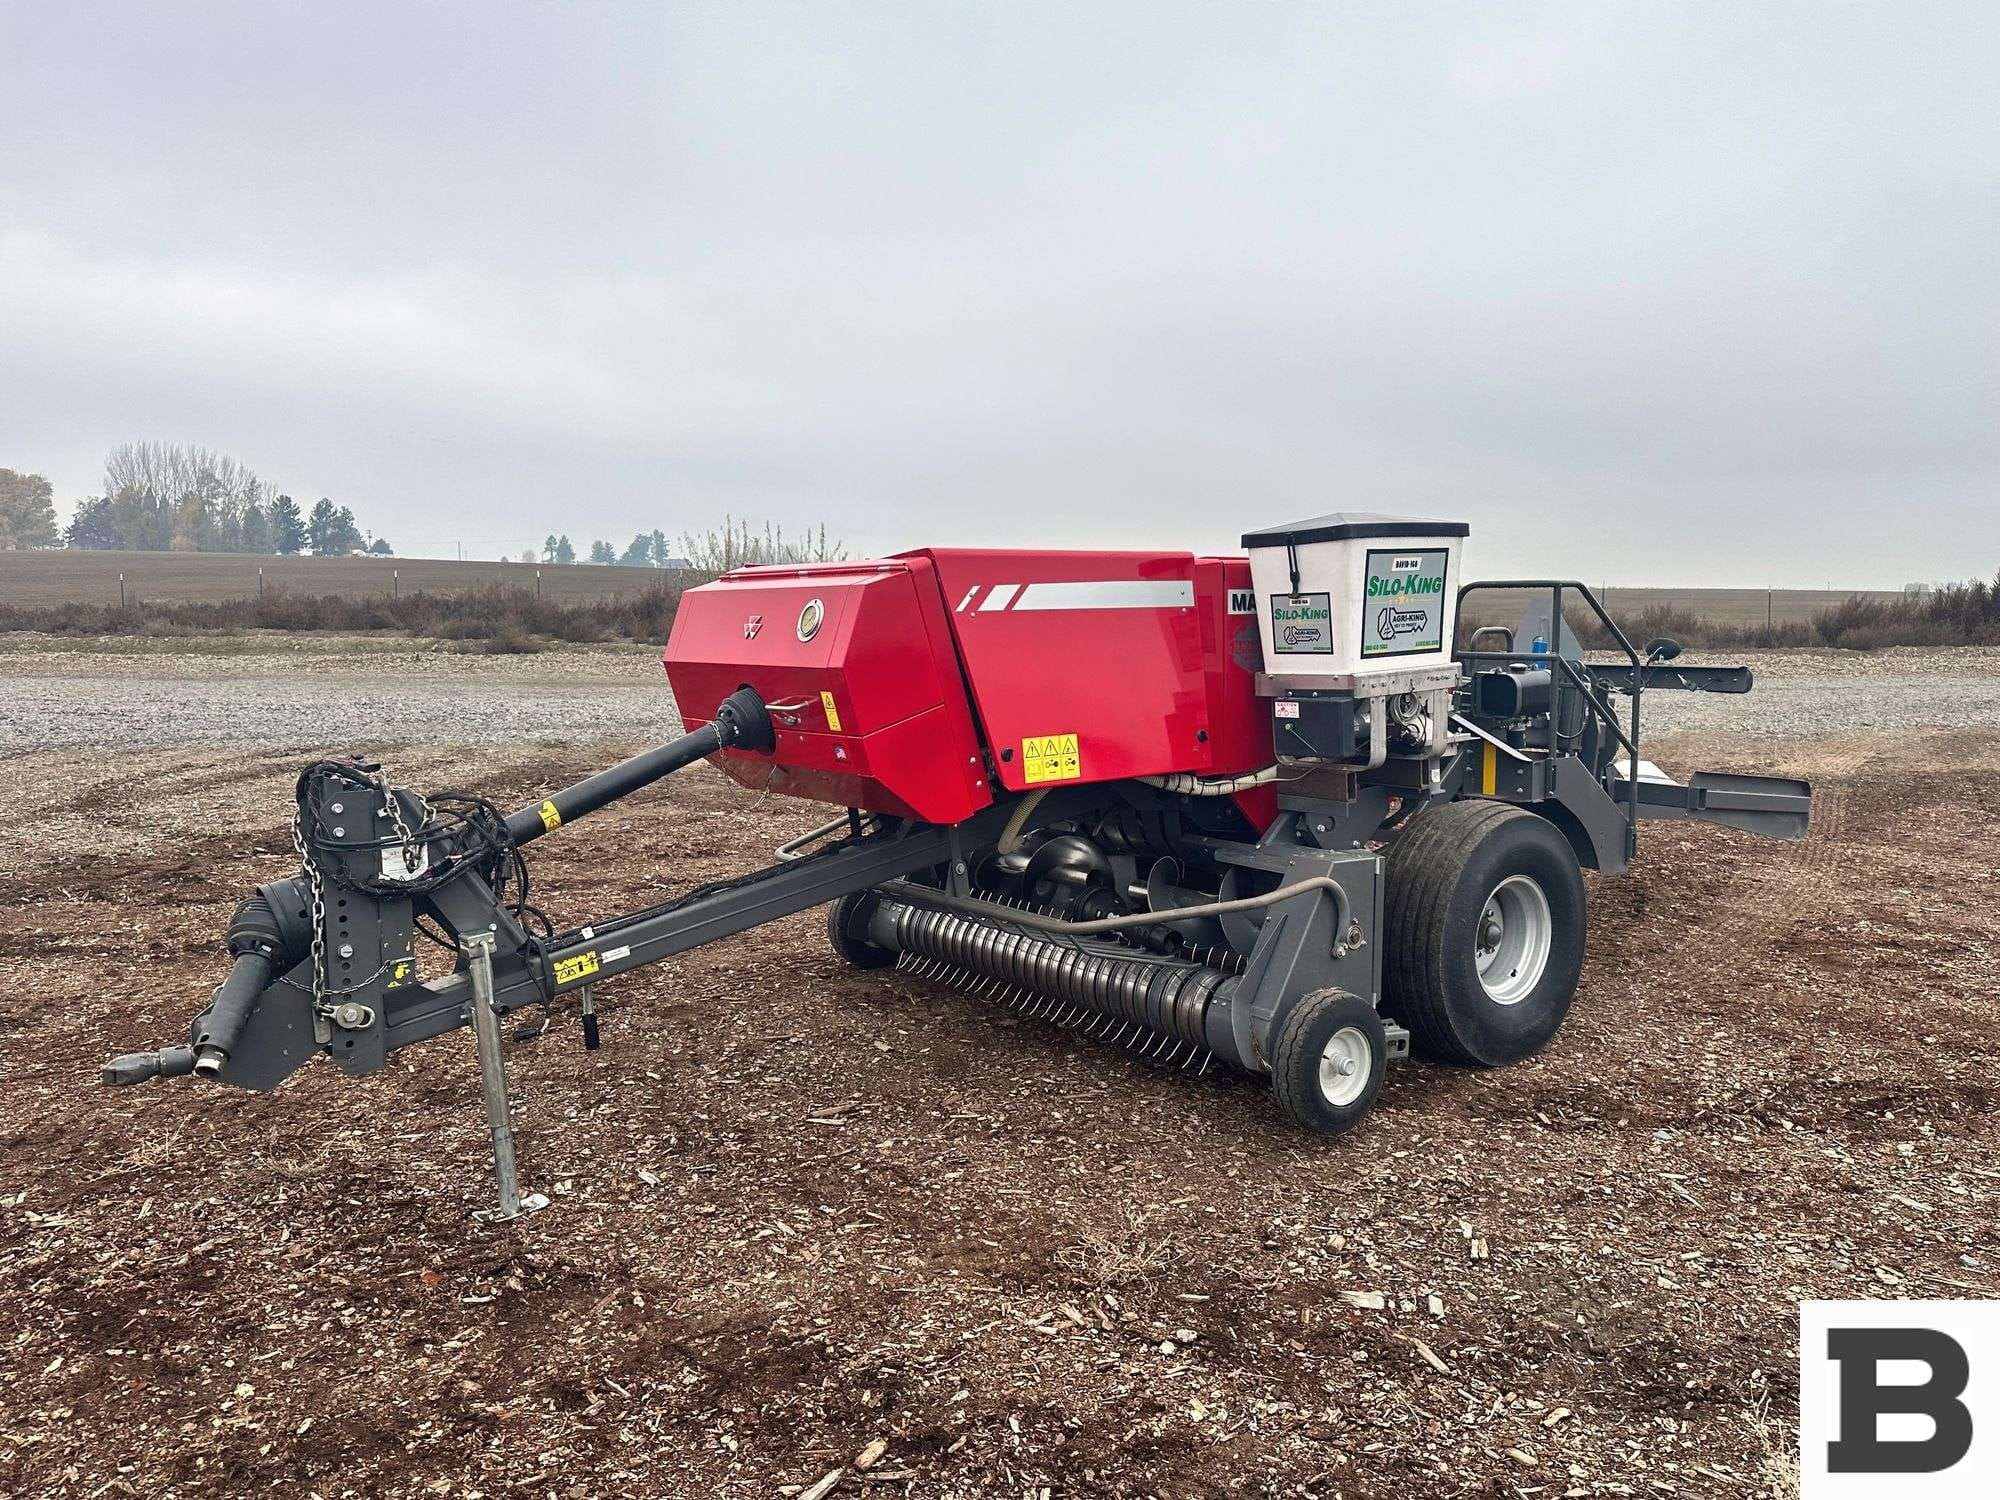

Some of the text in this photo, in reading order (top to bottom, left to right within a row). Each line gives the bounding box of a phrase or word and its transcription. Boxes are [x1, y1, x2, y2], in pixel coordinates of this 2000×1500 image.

[1368, 575, 1442, 597] SILO-KING
[1274, 607, 1328, 620] SILO-KING
[1392, 613, 1426, 623] AGRI-KING
